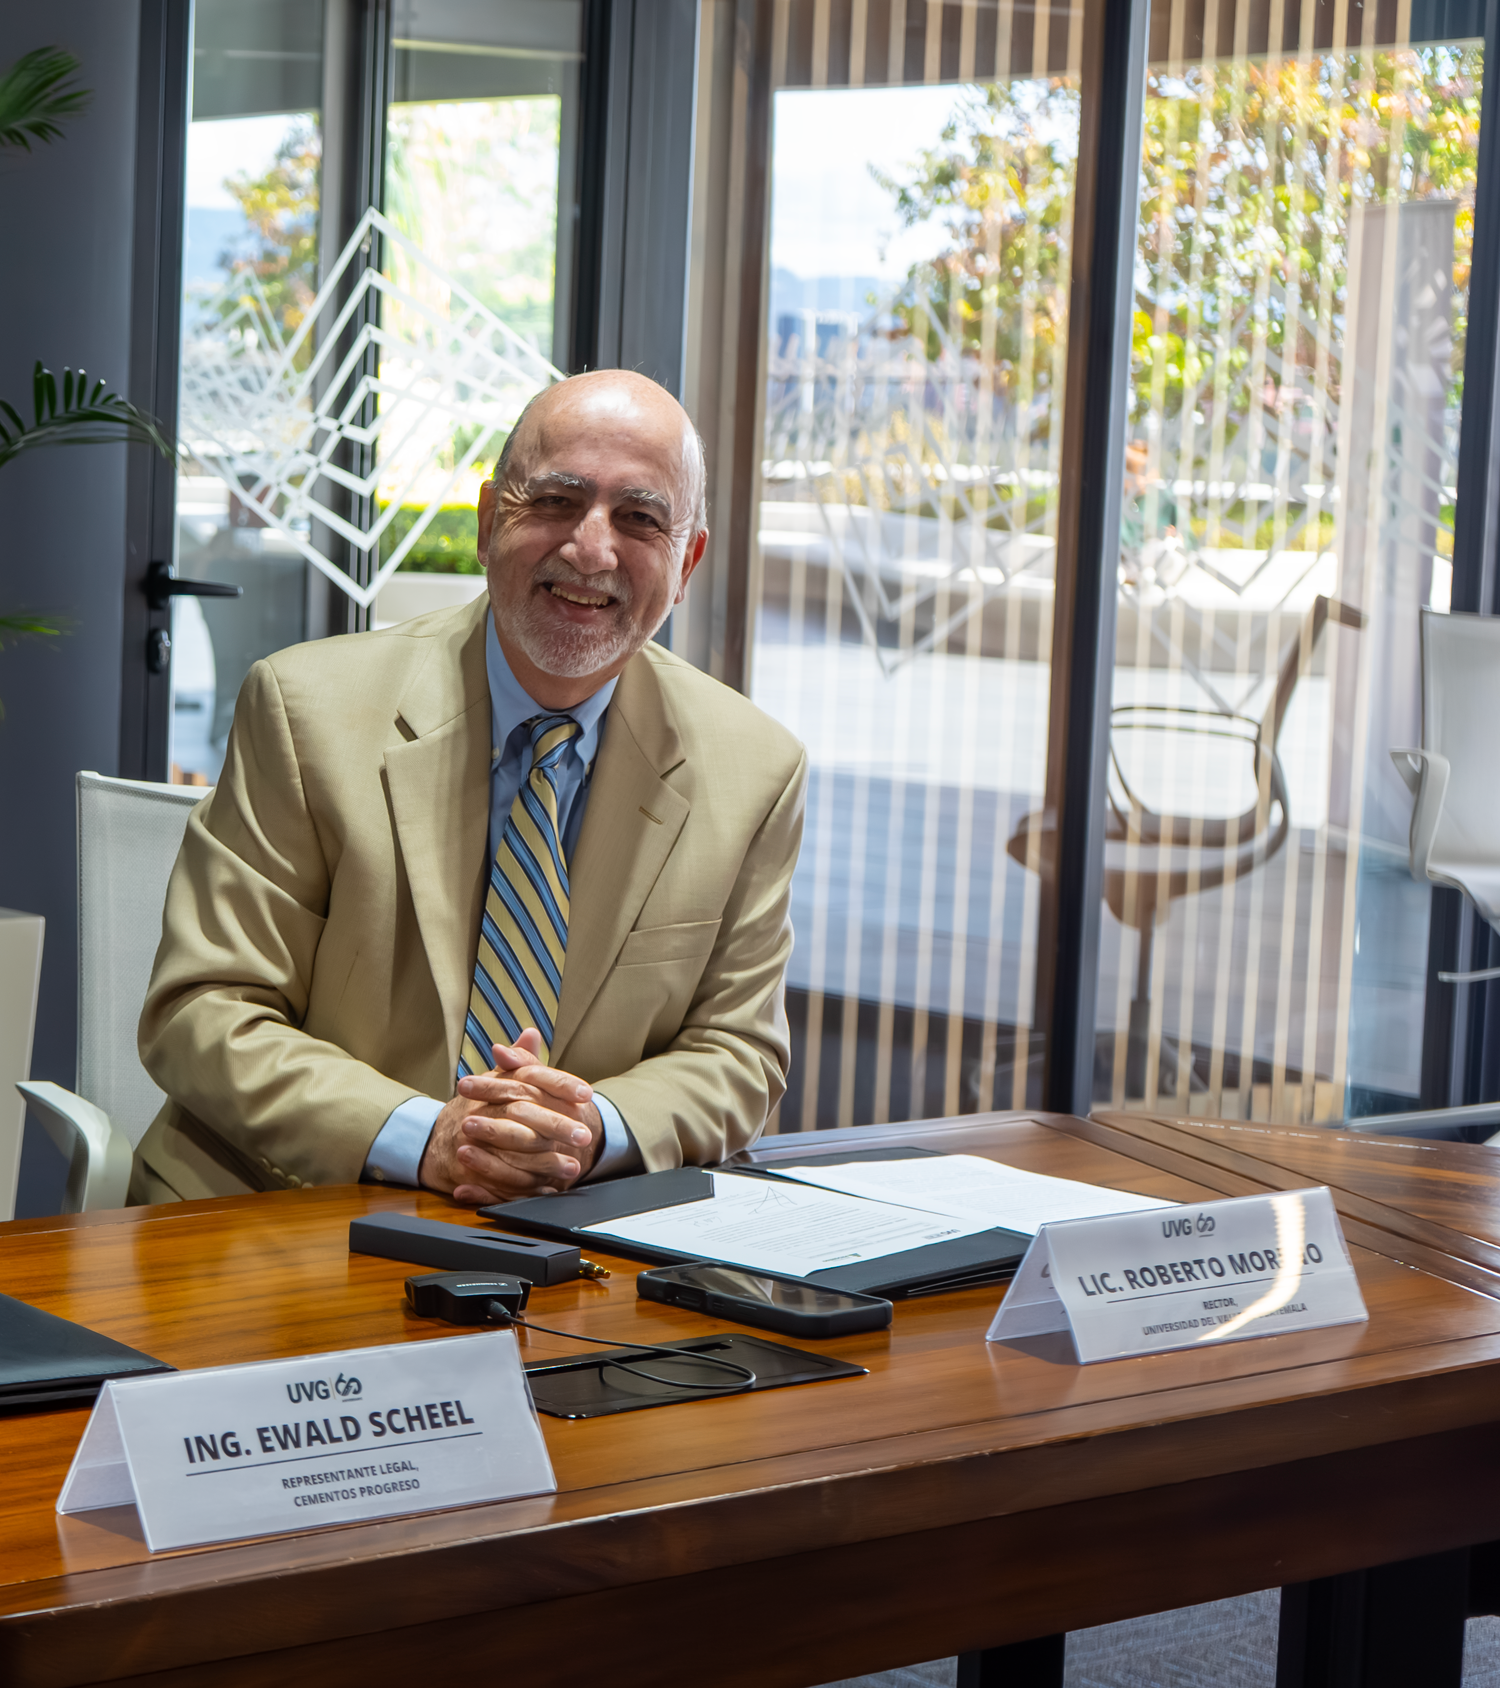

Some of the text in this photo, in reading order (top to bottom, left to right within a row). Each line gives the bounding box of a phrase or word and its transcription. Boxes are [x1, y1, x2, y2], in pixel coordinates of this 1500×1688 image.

[1162, 1218, 1192, 1238] UVG
[1078, 1242, 1323, 1297] LIC. ROBERTO MORO
[1202, 1297, 1238, 1310] RECTOR,
[1142, 1318, 1200, 1336] UNIVERSIDAD
[1200, 1316, 1217, 1327] DEL
[286, 1380, 331, 1404] UVG
[183, 1399, 475, 1464] ING. EWALD SCHEEL
[281, 1459, 419, 1490] REPRESENTANTE LEGAL,
[294, 1478, 421, 1508] CEMENTOS PROGRESO
